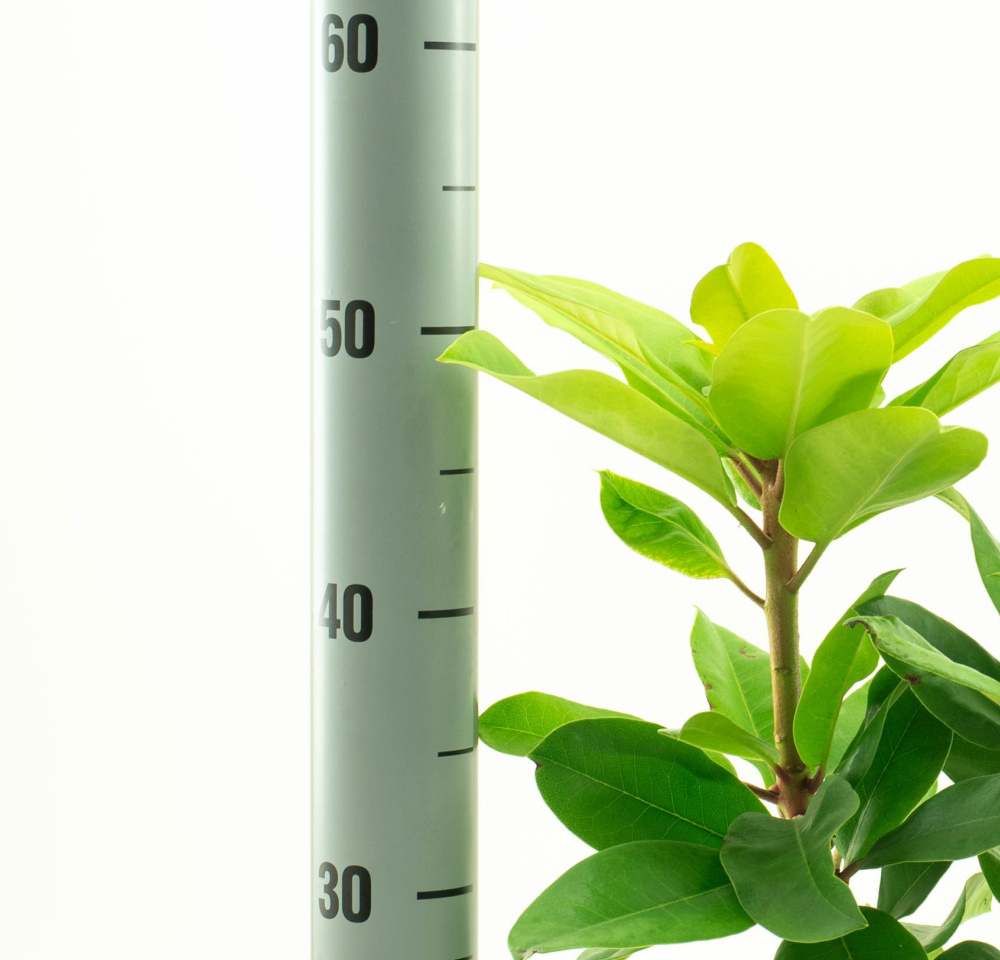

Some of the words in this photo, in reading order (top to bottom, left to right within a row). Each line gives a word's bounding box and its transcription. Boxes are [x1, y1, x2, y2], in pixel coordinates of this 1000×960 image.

[321, 13, 380, 73] 60
[319, 299, 377, 359] 50
[318, 582, 375, 643] 40
[318, 861, 373, 924] 30
